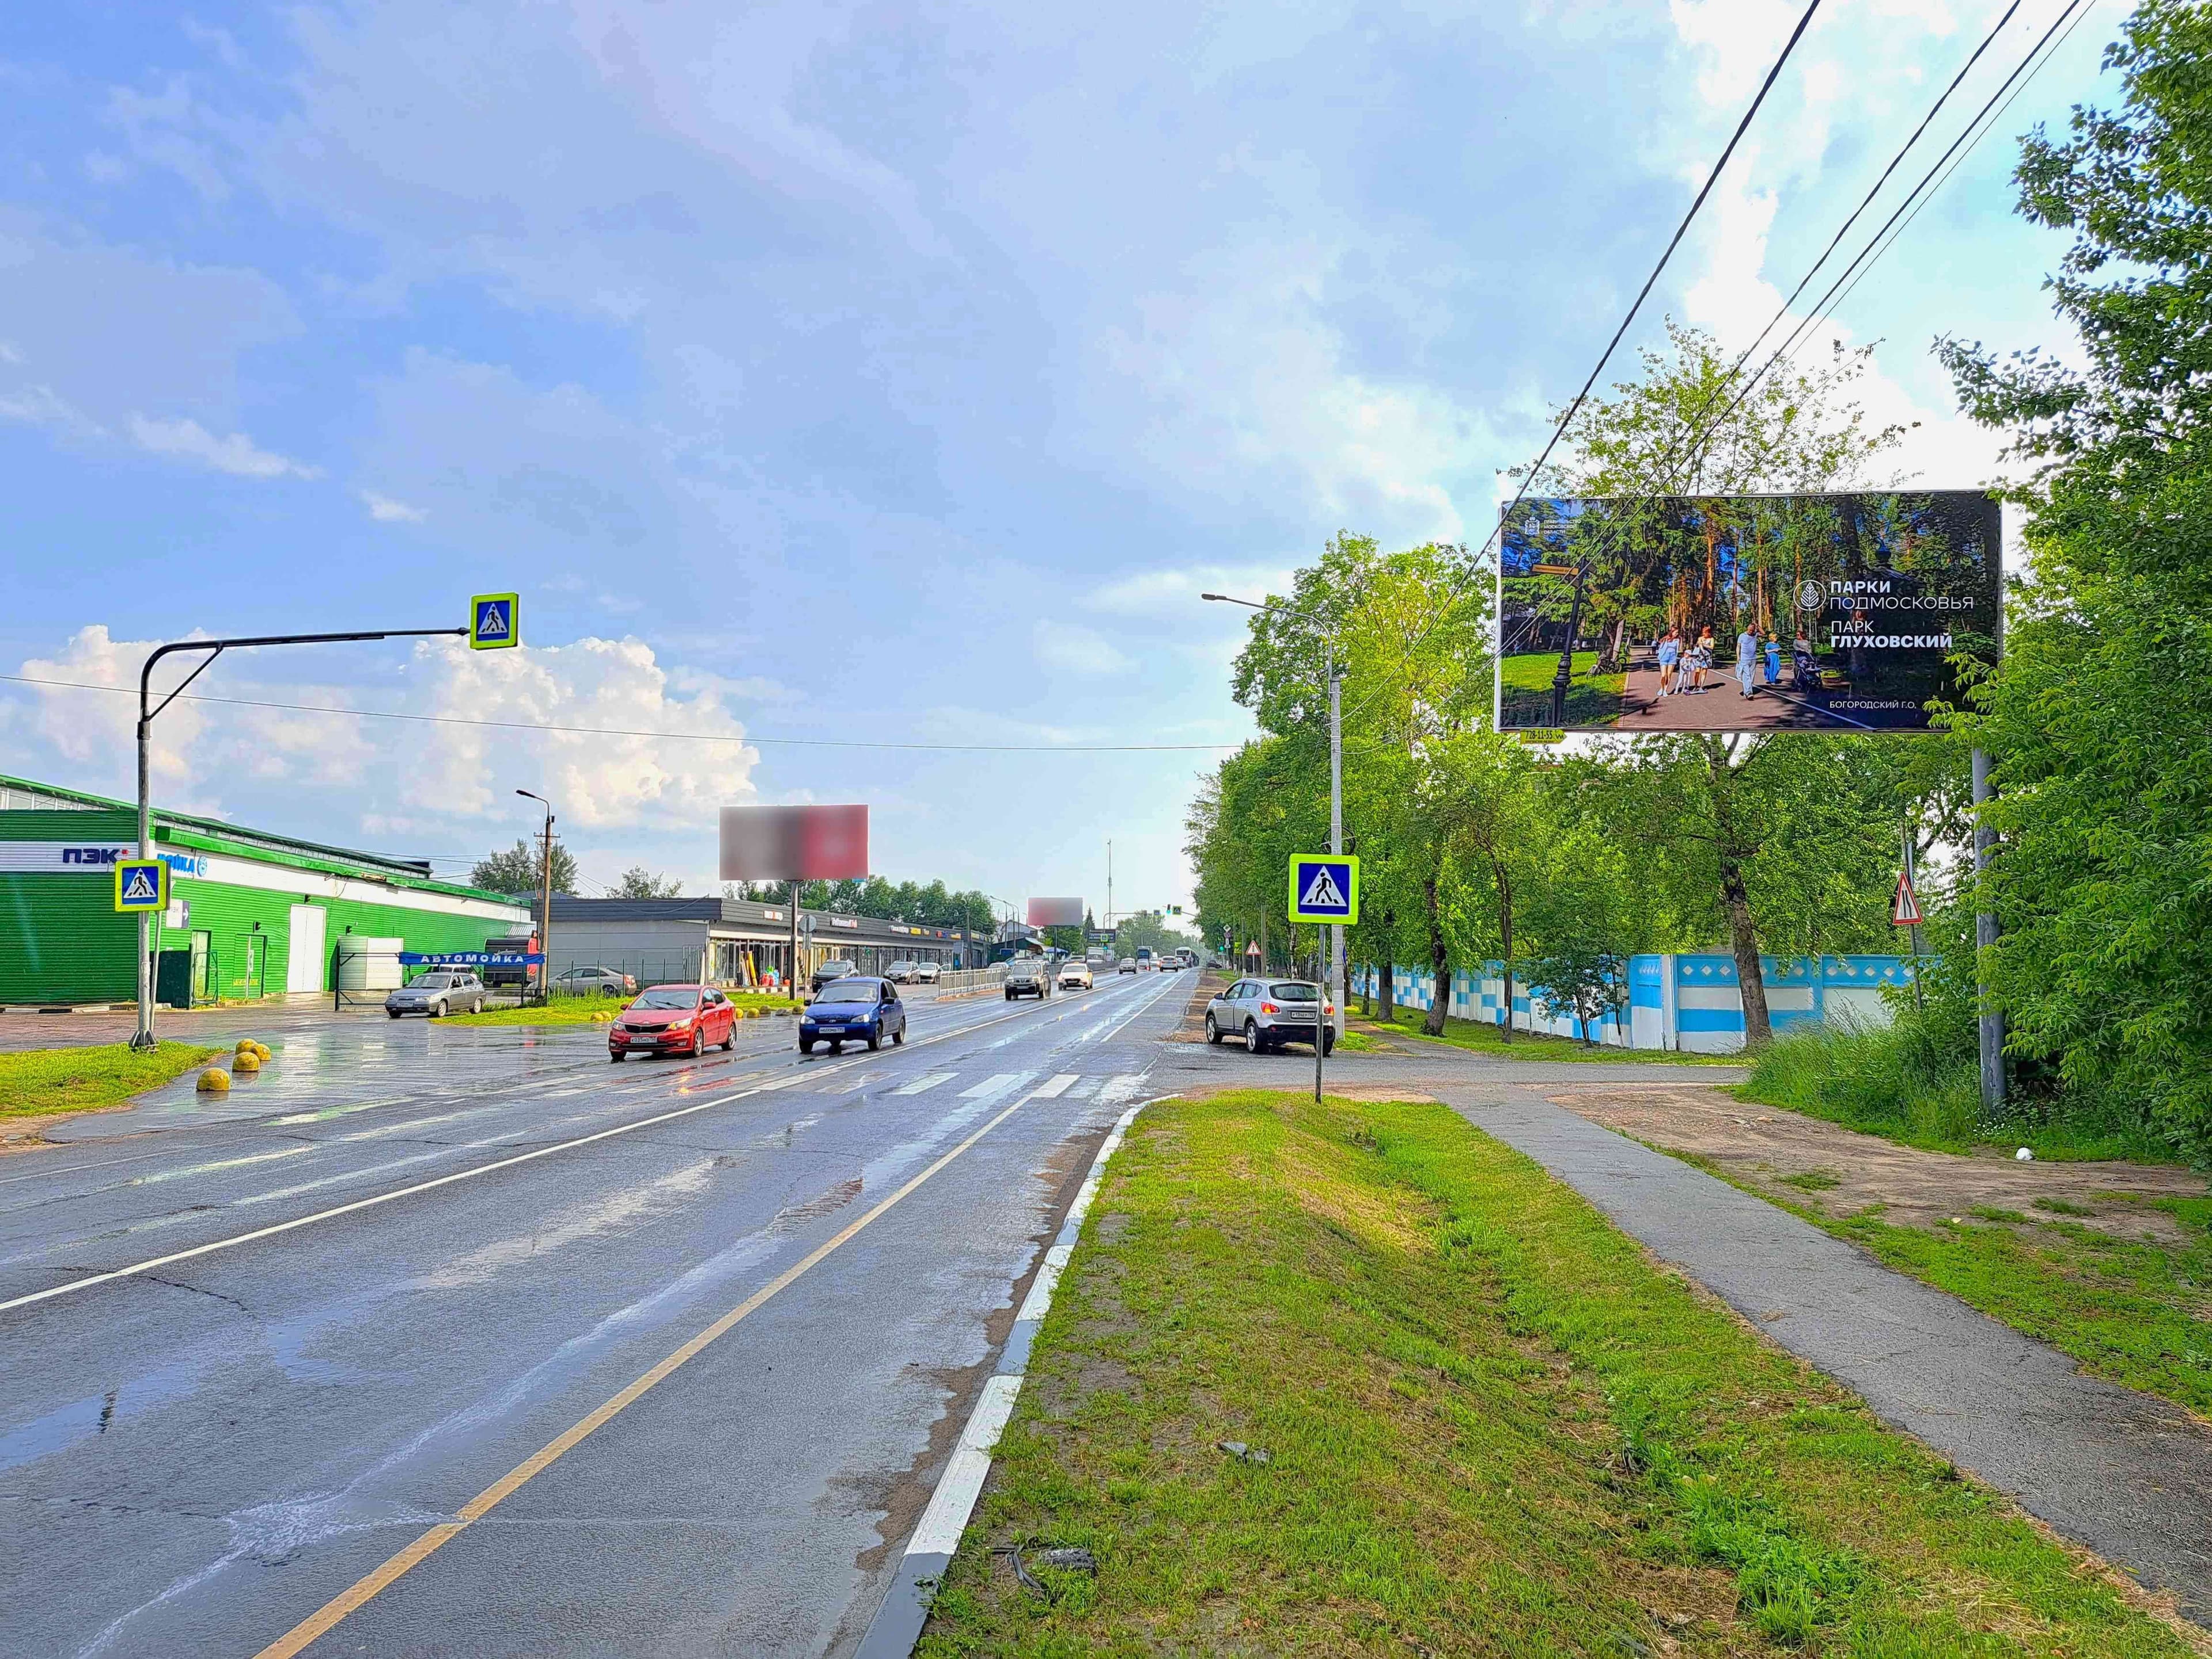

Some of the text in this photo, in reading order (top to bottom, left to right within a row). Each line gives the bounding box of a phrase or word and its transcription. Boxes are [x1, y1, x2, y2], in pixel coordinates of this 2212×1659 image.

[1831, 581, 1891, 593] ПАРКИ
[1830, 597, 1974, 610] ПОДМОСКОВЬЯ
[1831, 620, 1874, 633] ПАРК
[1831, 632, 1952, 648] ГЛУХОВСКИЙ
[1830, 700, 1899, 709] БОГОРОДСКИЙ
[421, 954, 524, 963] АВТОМОЙКА
